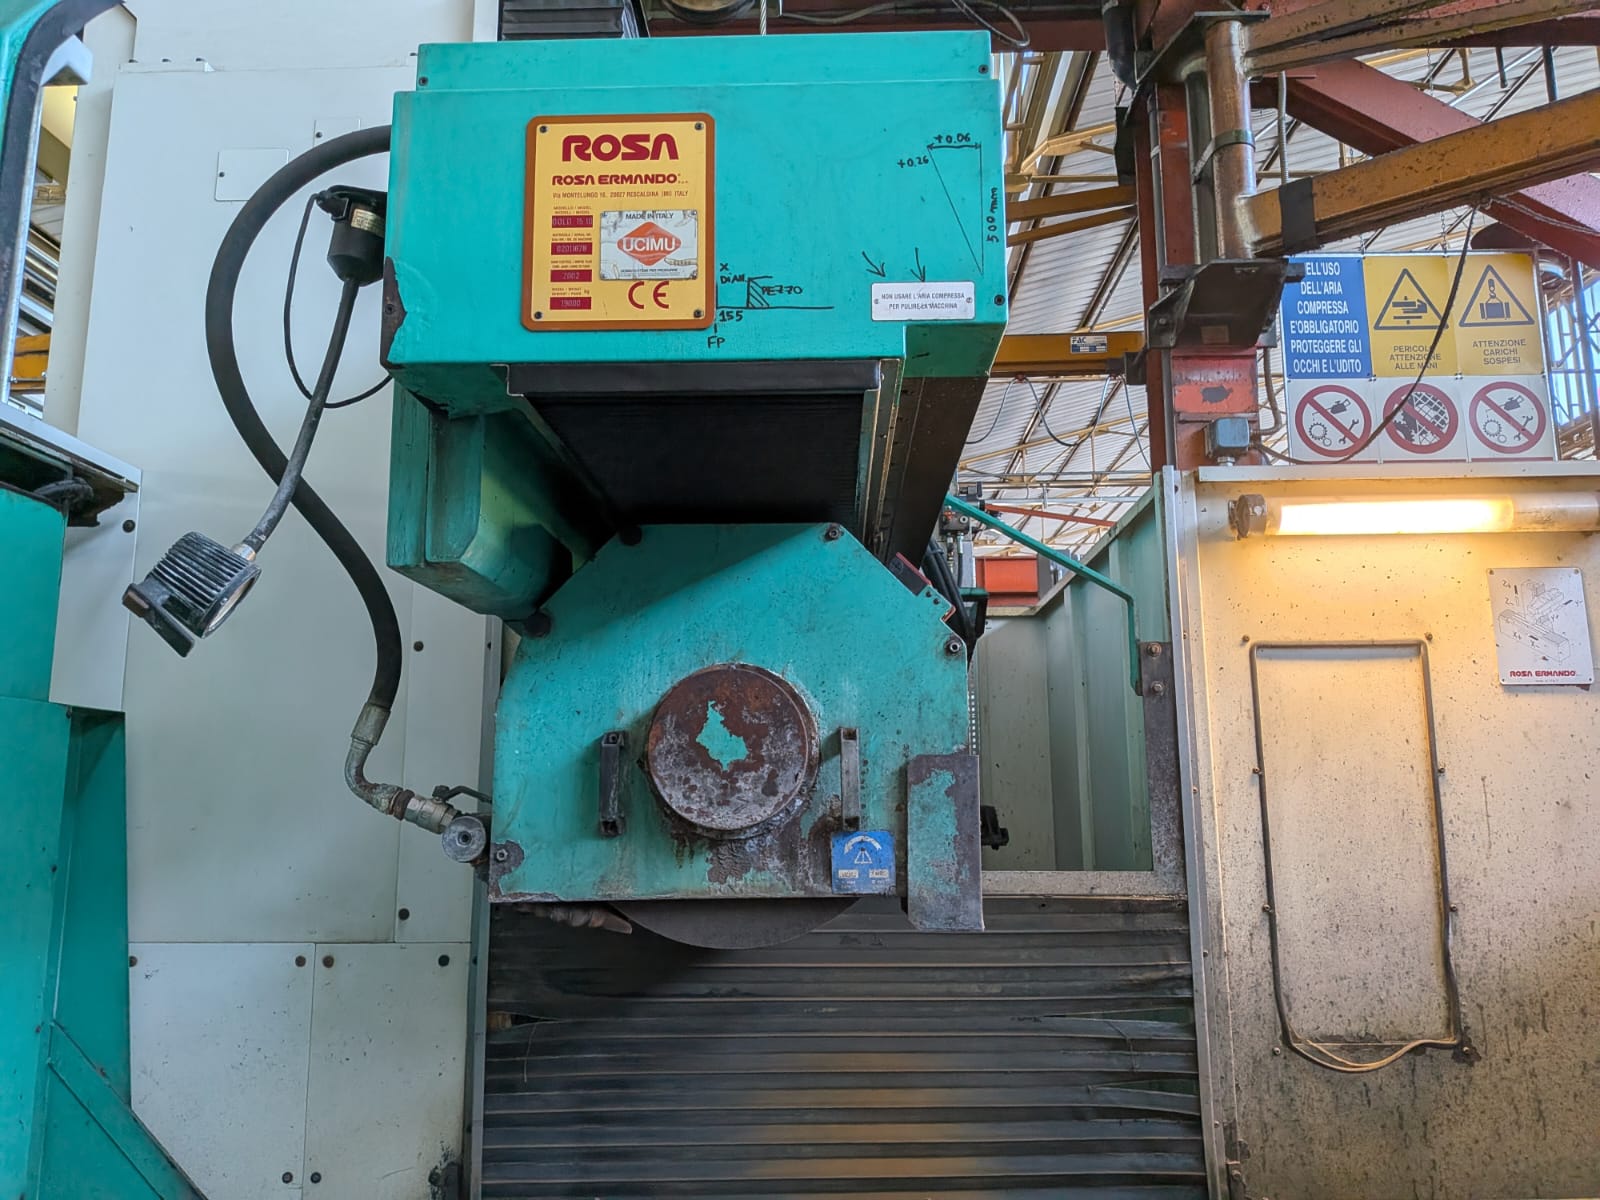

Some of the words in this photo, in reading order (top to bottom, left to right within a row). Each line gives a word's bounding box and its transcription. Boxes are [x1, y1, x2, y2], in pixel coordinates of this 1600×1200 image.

[934, 133, 971, 144] +0.06
[562, 134, 679, 162] ROSA
[897, 155, 929, 168] +0.26
[552, 175, 595, 185] ROSA
[597, 174, 677, 185] ERMANDO
[986, 215, 999, 243] 500
[622, 236, 676, 251] UCIMU
[1303, 262, 1341, 276] ELL'USO
[1300, 281, 1343, 295] DELL'ARIA
[1297, 301, 1349, 315] COMPRESSA
[719, 310, 744, 322] 155
[1290, 320, 1360, 334] E'OBBLIGATORIO
[1291, 340, 1347, 354] PROTEGGERE
[1348, 340, 1362, 354] GLI
[1393, 345, 1432, 353] PERICOL
[1472, 339, 1526, 348] ATTENZIONE
[1483, 348, 1518, 357] CARICHI
[1293, 360, 1321, 374] OCCHI
[1322, 360, 1328, 373] E
[1329, 359, 1362, 373] L'UDITO
[1394, 362, 1415, 370] ALLE
[1483, 356, 1520, 365] SOSPESI
